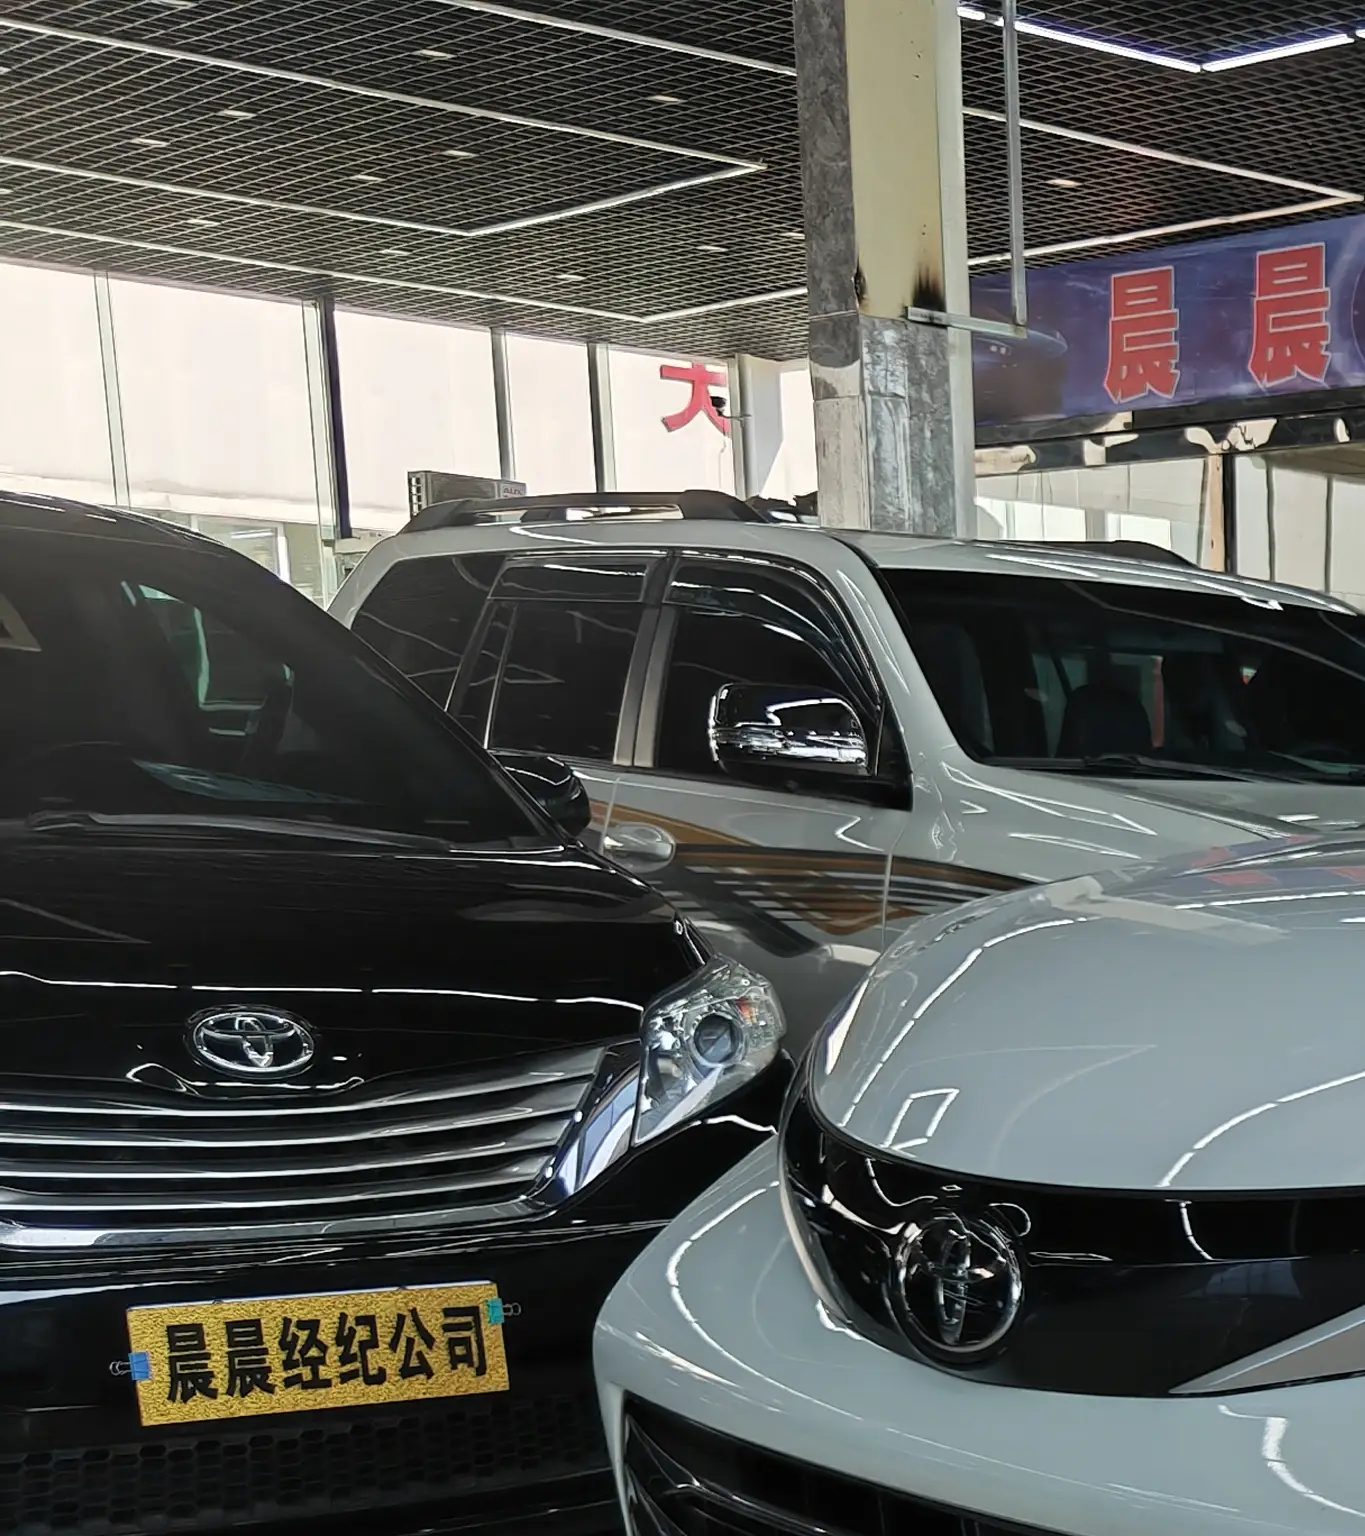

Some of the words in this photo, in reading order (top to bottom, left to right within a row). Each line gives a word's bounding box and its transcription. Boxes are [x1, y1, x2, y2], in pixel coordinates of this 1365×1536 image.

[166, 1305, 490, 1404] 晨晨经纪公司
